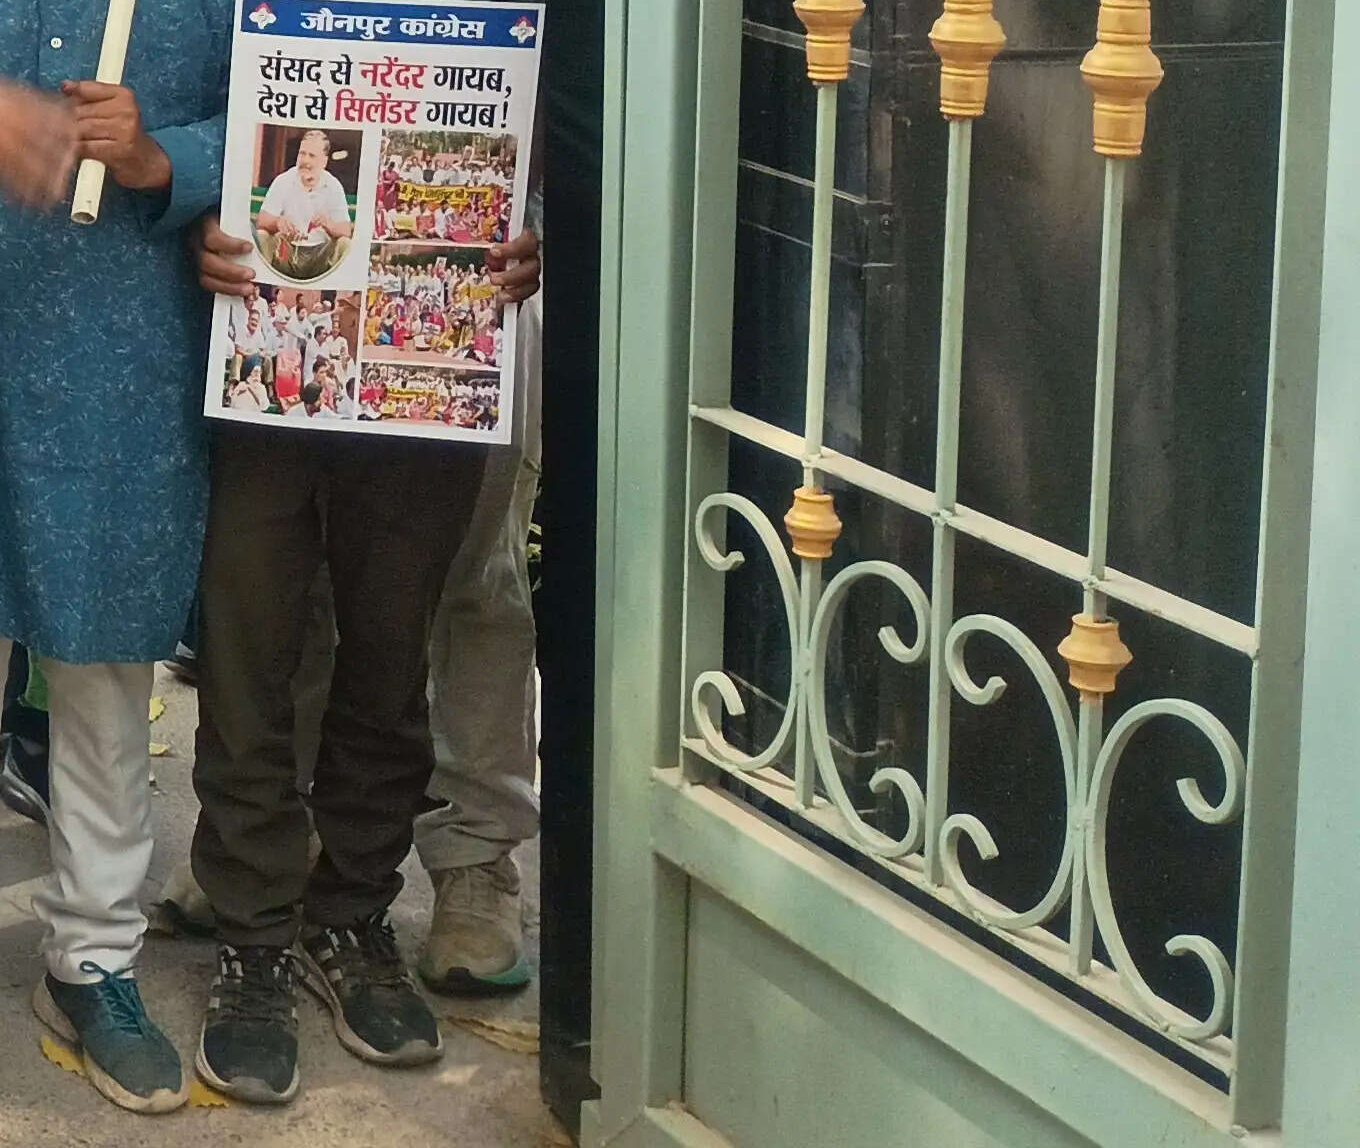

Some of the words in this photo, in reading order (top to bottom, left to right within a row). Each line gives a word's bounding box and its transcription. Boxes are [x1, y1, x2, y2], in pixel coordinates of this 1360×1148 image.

[300, 7, 391, 40] जौनपुर
[399, 13, 486, 39] कांग्रेस
[258, 50, 324, 84] संसद
[330, 53, 353, 86] से
[359, 55, 428, 89] नरेंदर
[433, 65, 512, 98] गायब,
[257, 84, 298, 119] देश
[304, 88, 329, 121] से
[334, 88, 421, 124] सिलेंडर
